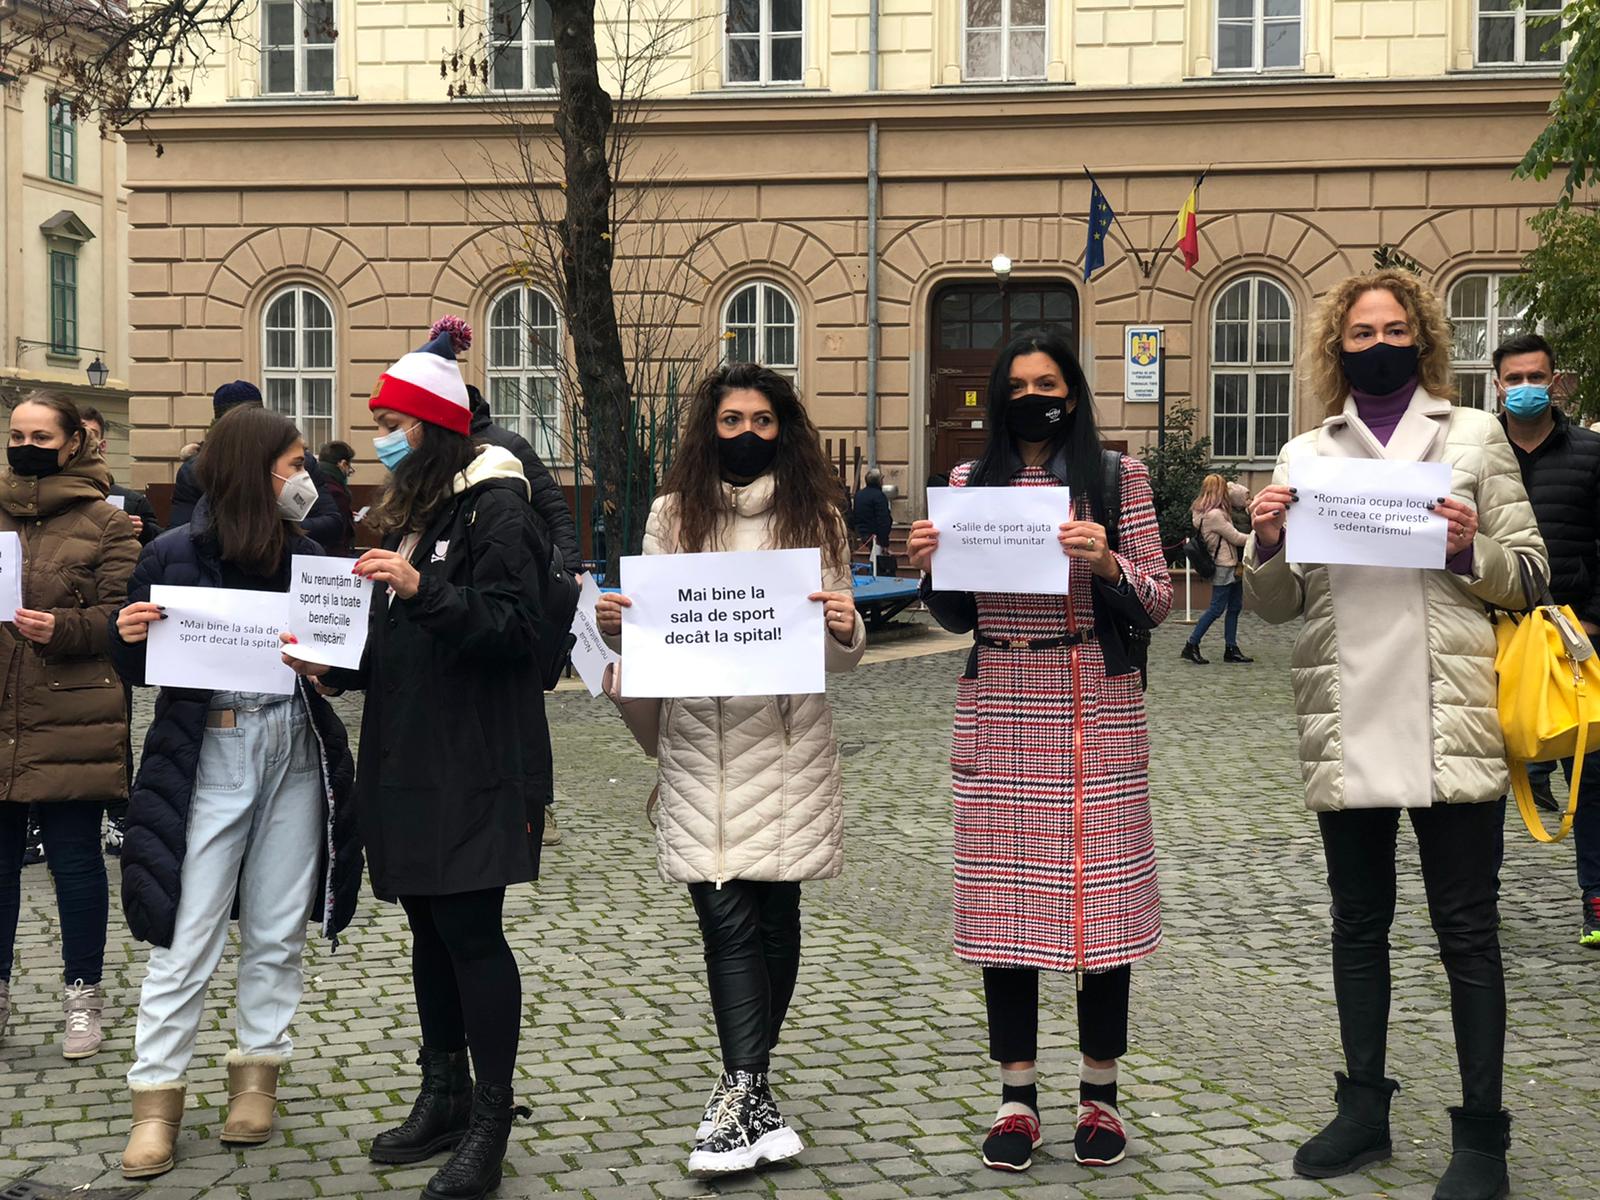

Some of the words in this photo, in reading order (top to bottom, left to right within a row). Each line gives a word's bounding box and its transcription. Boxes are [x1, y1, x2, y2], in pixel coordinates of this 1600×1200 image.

[1318, 493, 1366, 505] Romania
[1369, 498, 1402, 508] ocupa
[1318, 507, 1324, 516] 2
[1328, 508, 1337, 516] in
[1340, 510, 1366, 520] ceea
[1369, 512, 1381, 520] ce
[1384, 512, 1429, 523] priveste
[956, 522, 982, 532] Salile
[984, 522, 996, 532] de
[998, 523, 1024, 533] sport
[1026, 523, 1051, 534] ajuta
[1334, 522, 1411, 536] sedentarismul
[962, 536, 1000, 545] sistemul
[1004, 536, 1046, 545] imunitar
[301, 572, 312, 584] Nu
[314, 575, 352, 589] renunțăm
[354, 576, 362, 588] la
[300, 594, 320, 605] sport
[322, 593, 330, 608] și
[332, 593, 338, 606] la
[340, 596, 361, 608] toate
[678, 588, 707, 602] Mai
[712, 587, 746, 600] bine
[751, 586, 765, 599] la
[670, 610, 702, 623] sala
[708, 608, 728, 622] de
[732, 607, 775, 623] sport
[184, 620, 204, 630] Mai
[206, 622, 230, 632] bine
[232, 624, 240, 632] la
[244, 624, 264, 634] sala
[266, 626, 279, 635] de
[179, 634, 206, 643] sport
[210, 635, 238, 646] decat
[240, 637, 250, 646] la
[252, 639, 280, 648] spital
[664, 630, 710, 644] decât
[715, 630, 728, 642] la
[734, 627, 782, 644] spital!
